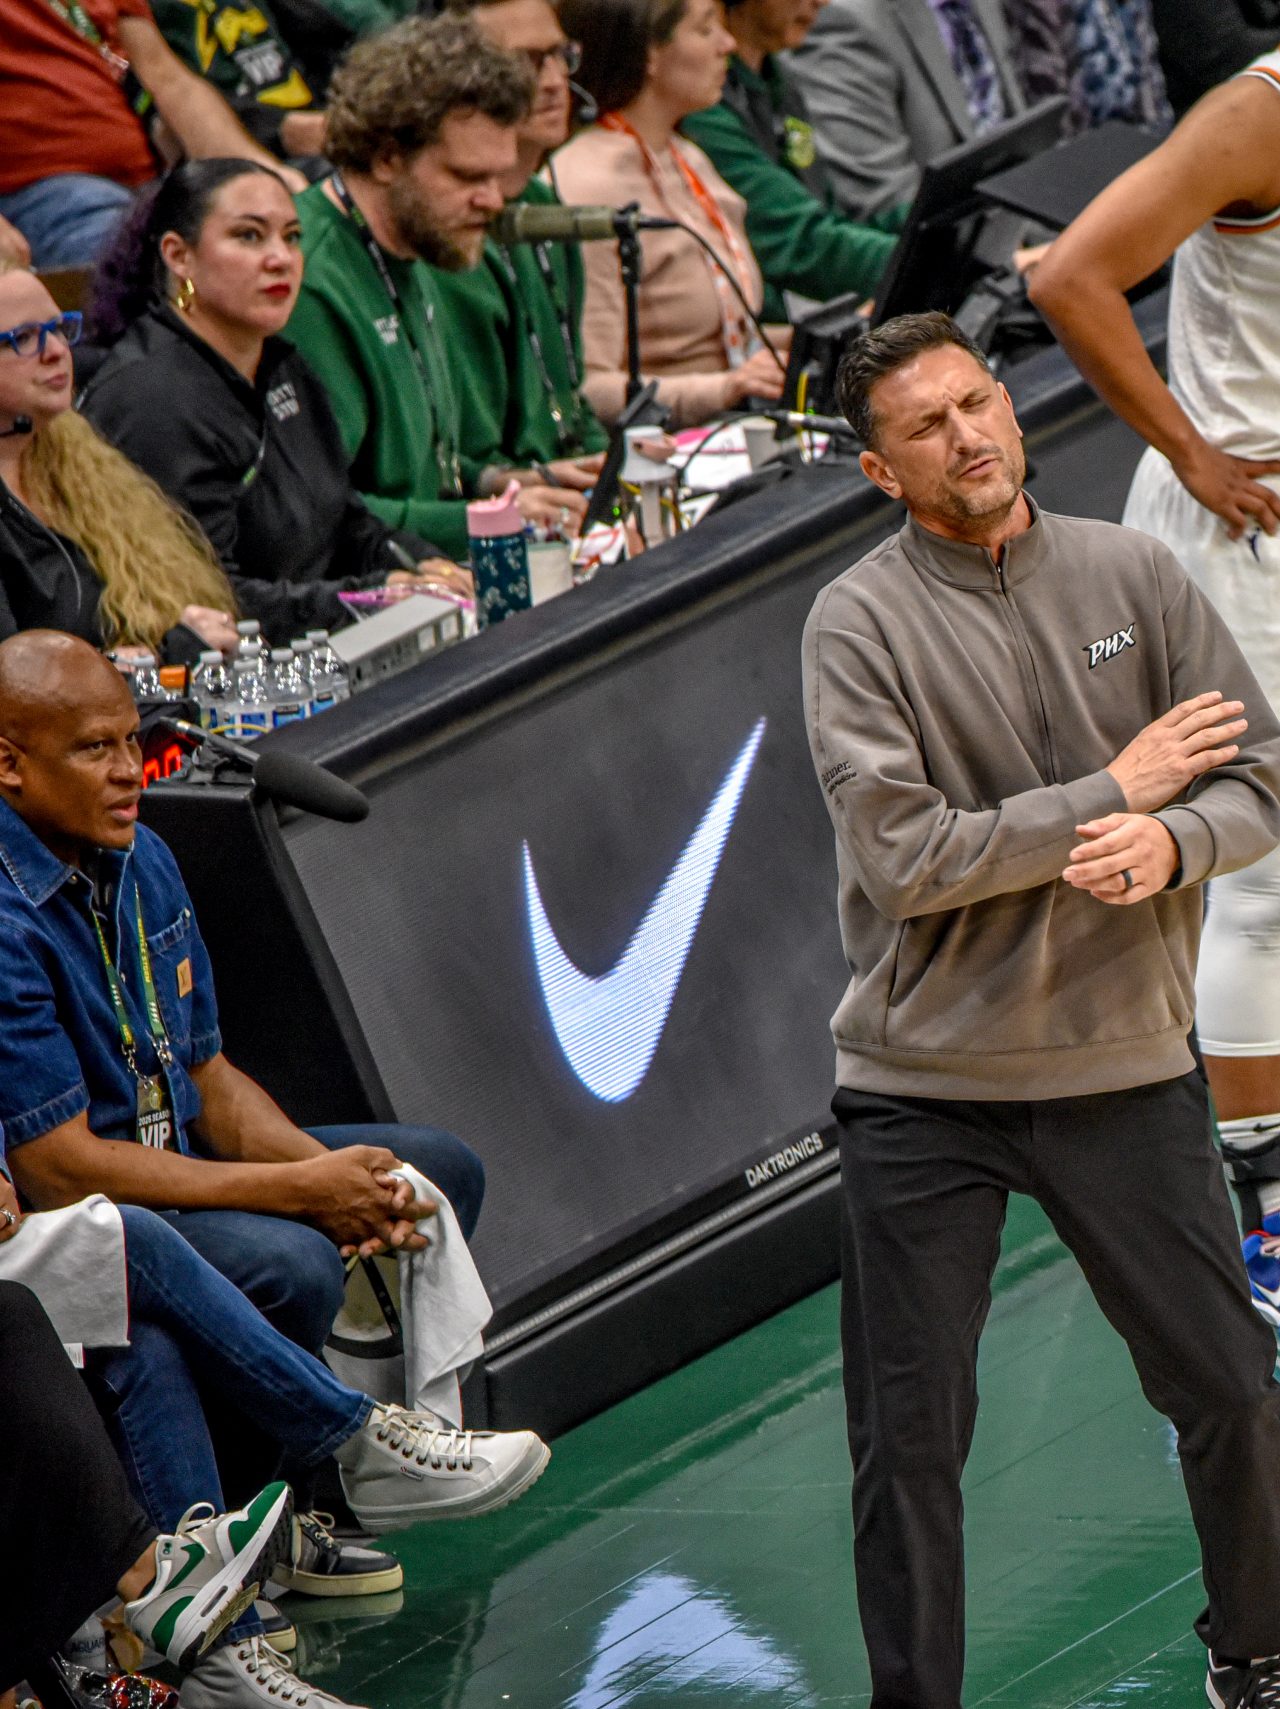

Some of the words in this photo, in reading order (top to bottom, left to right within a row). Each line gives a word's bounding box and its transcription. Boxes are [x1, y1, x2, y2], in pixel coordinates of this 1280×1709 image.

[1082, 622, 1137, 670] PHX
[151, 1108, 171, 1121] SEASO
[140, 1120, 172, 1151] VIP
[744, 1131, 824, 1189] DAKTRONICS
